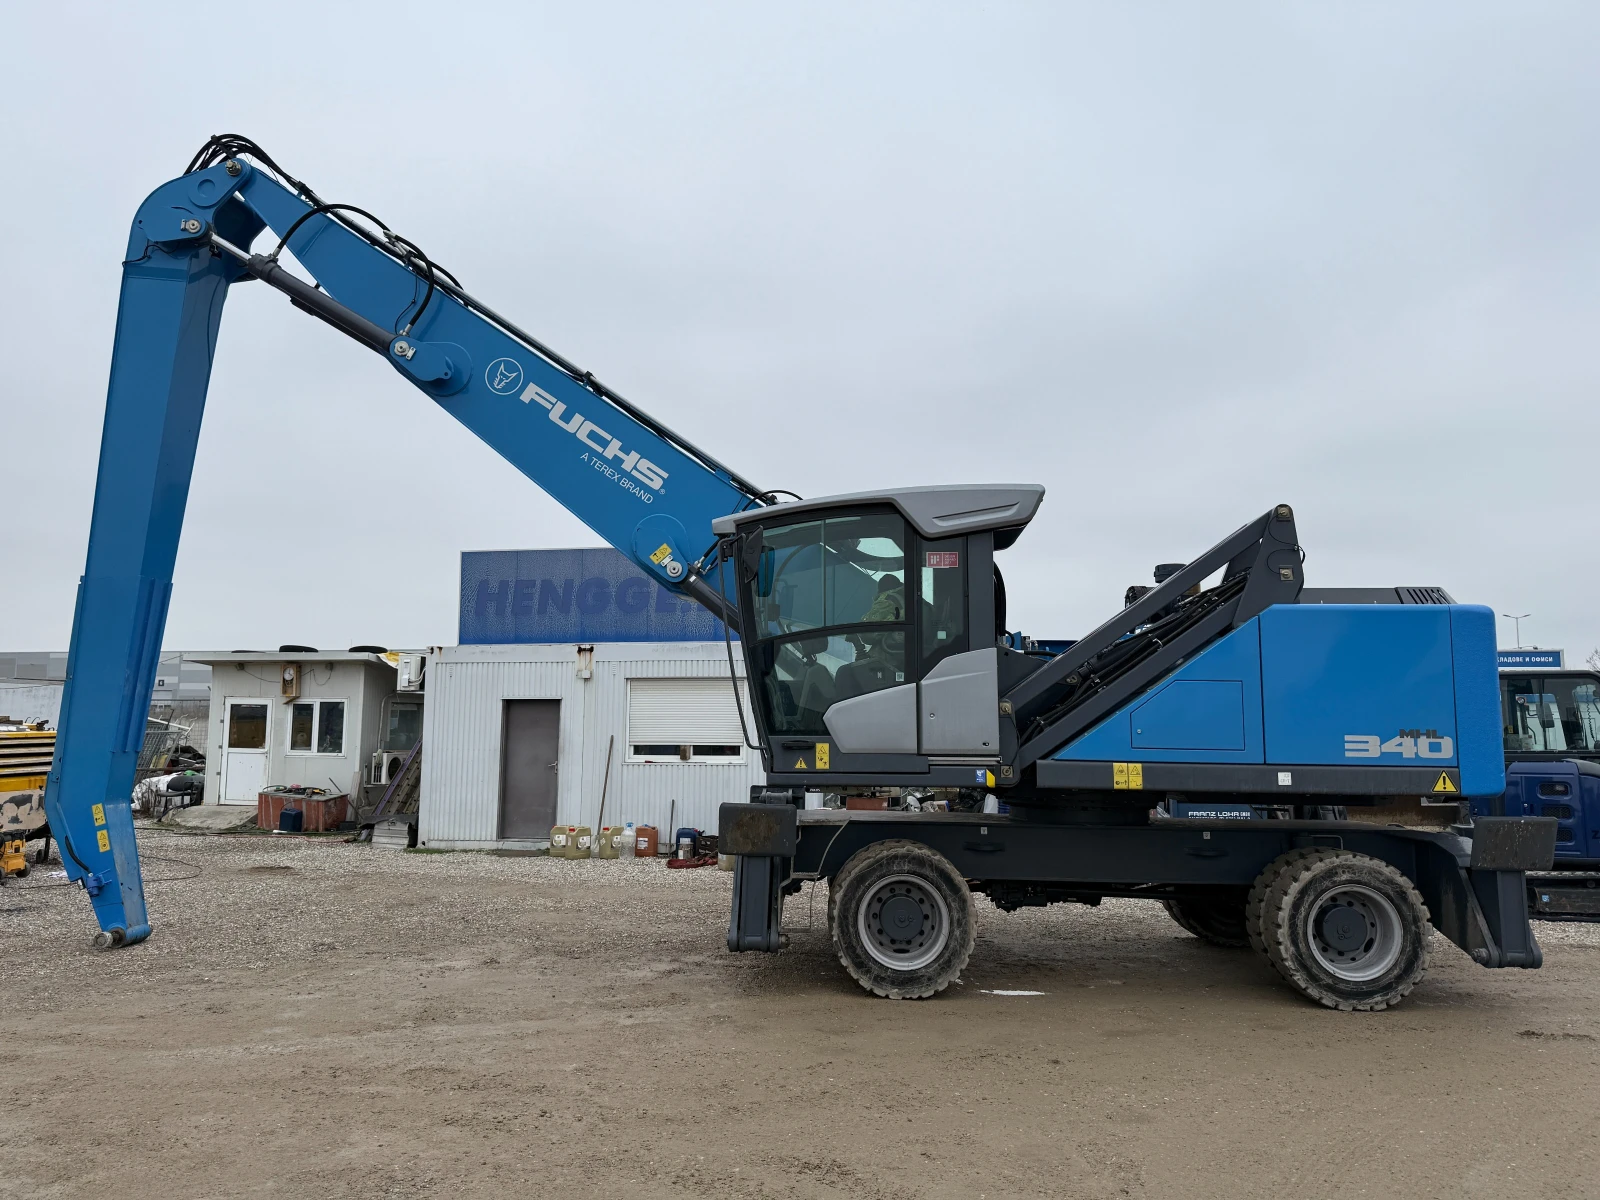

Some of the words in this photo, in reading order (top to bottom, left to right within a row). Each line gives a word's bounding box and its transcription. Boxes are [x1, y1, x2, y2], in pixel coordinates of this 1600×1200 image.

[519, 382, 669, 490] FUCHS
[580, 452, 589, 462] A
[590, 456, 621, 482] TEREX
[619, 477, 653, 504] BRAND
[1344, 734, 1454, 759] 340
[1399, 728, 1444, 739] MHL
